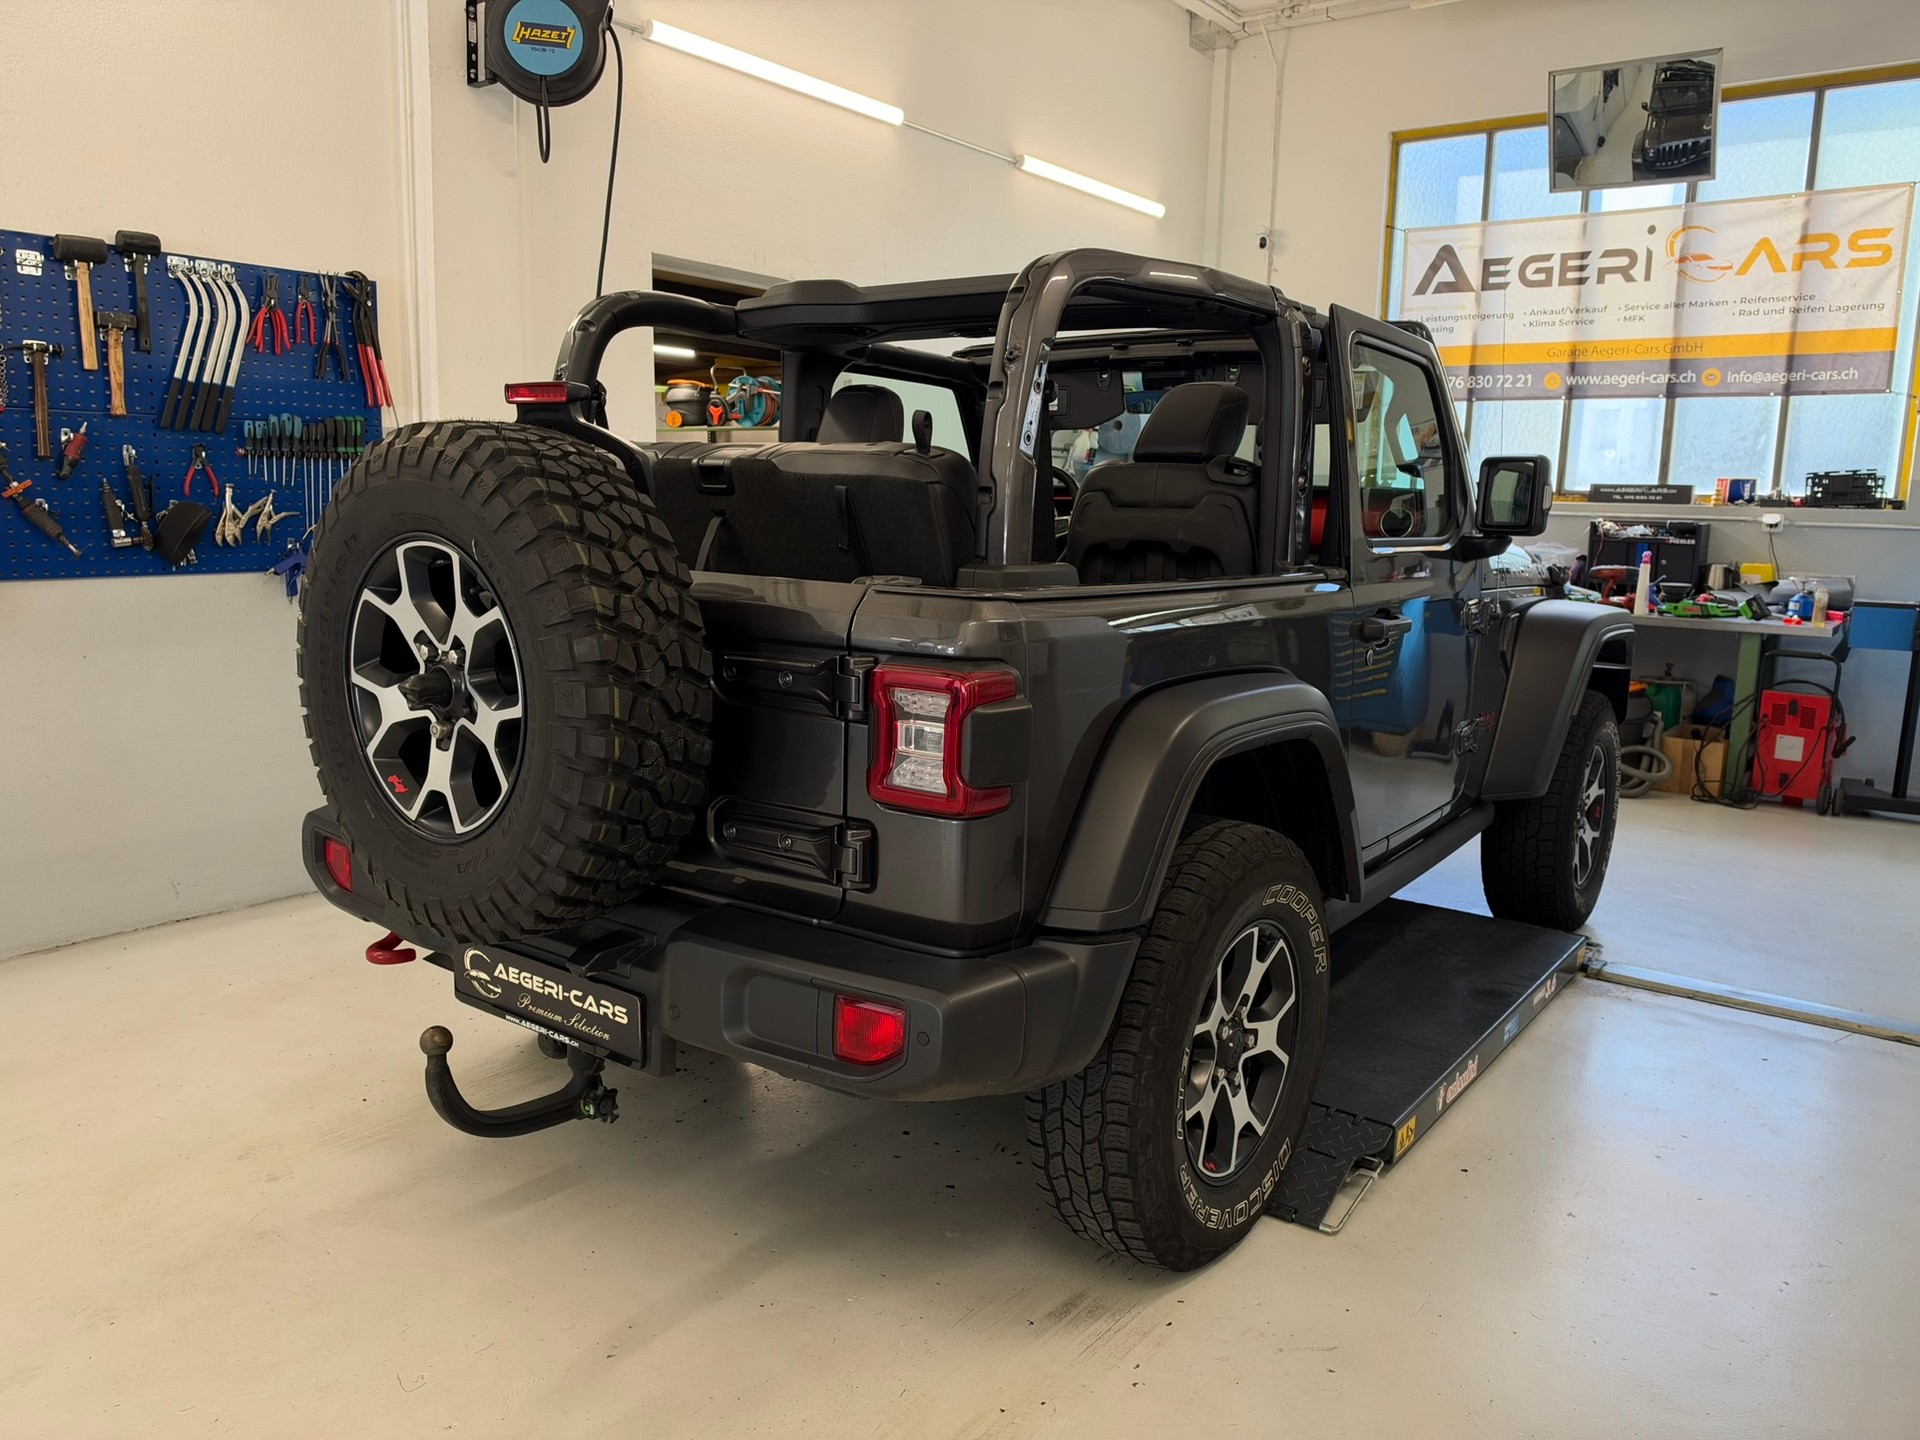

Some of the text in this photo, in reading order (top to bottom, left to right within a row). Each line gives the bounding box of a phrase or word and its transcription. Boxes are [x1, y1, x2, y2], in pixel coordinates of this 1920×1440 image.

[1624, 298, 1729, 312] Service aller Marken
[1740, 292, 1816, 305] Reifenservice
[1421, 311, 1515, 323] Leistungssteigerung
[1529, 304, 1608, 317] Ankauf/Verkauf
[1738, 302, 1885, 317] Rad und Reifen Lagerung
[1529, 318, 1595, 328] Klima Service
[1623, 314, 1646, 323] MFK
[1430, 325, 1454, 334] asing
[1547, 341, 1704, 359] Garage Aegeri-Cars GmbH
[1448, 373, 1532, 389] 76 830 72 21
[1565, 369, 1697, 388] www.aegeri-cars.ch
[1726, 367, 1858, 384] info@aegeri-cars.ch
[1263, 884, 1328, 975] COOPER
[493, 962, 629, 1025] AEGERI-CARS
[516, 992, 612, 1041] Premium Selection
[1178, 1136, 1292, 1230] DISCOVERER
